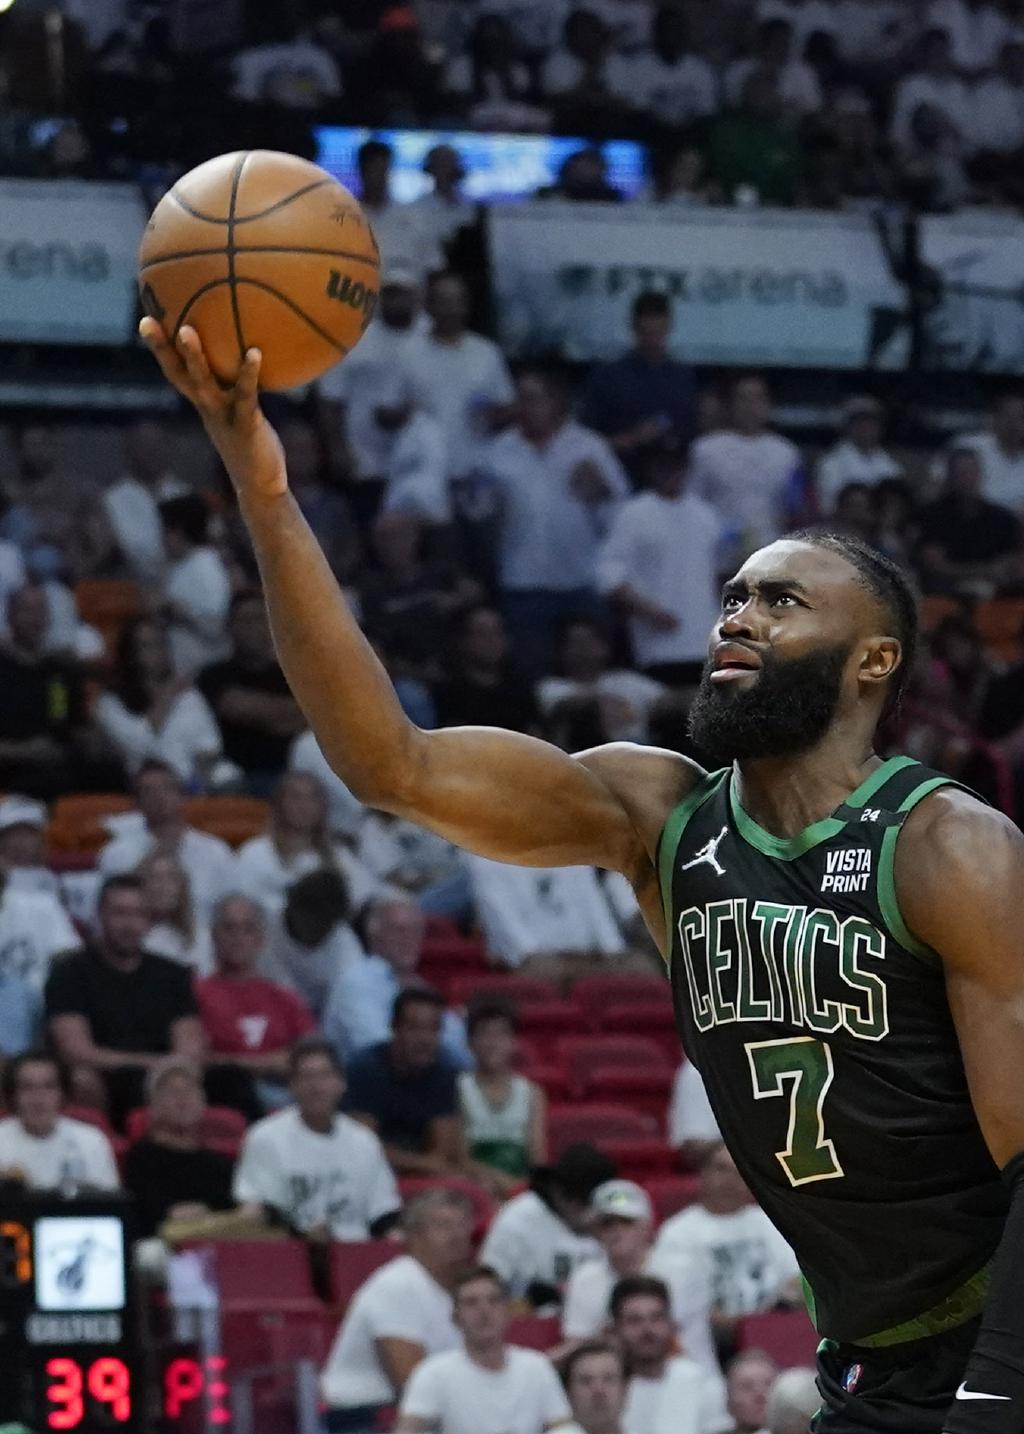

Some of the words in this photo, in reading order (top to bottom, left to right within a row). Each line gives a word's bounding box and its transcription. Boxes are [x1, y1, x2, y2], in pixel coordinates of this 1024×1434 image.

[860, 808, 881, 822] 24
[820, 872, 871, 893] PRINT
[826, 848, 872, 874] VISTA
[678, 898, 889, 1041] CELTICS
[743, 1036, 845, 1187] 7
[45, 1356, 131, 1431] 39
